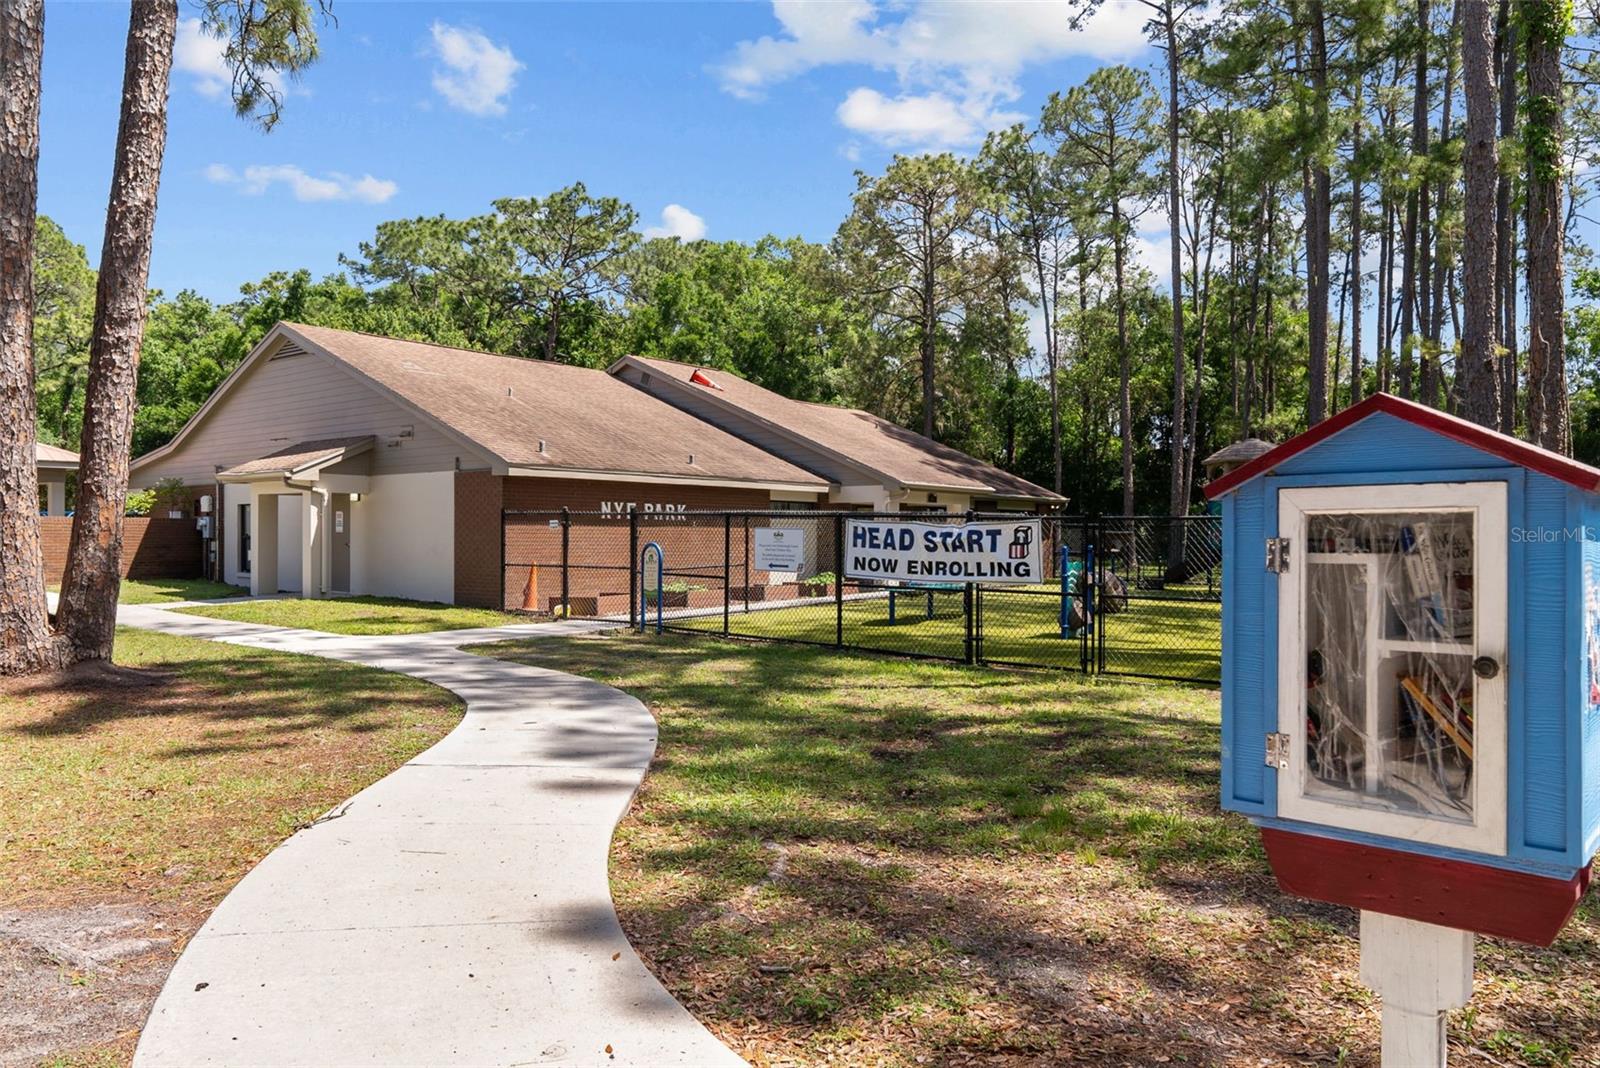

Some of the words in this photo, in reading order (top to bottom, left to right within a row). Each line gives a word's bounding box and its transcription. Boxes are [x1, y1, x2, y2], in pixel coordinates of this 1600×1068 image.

[644, 503, 687, 520] PARK
[852, 525, 915, 551] HEAD
[923, 529, 1002, 553] START
[853, 556, 899, 573] NOW
[907, 560, 1031, 577] ENROLLING
